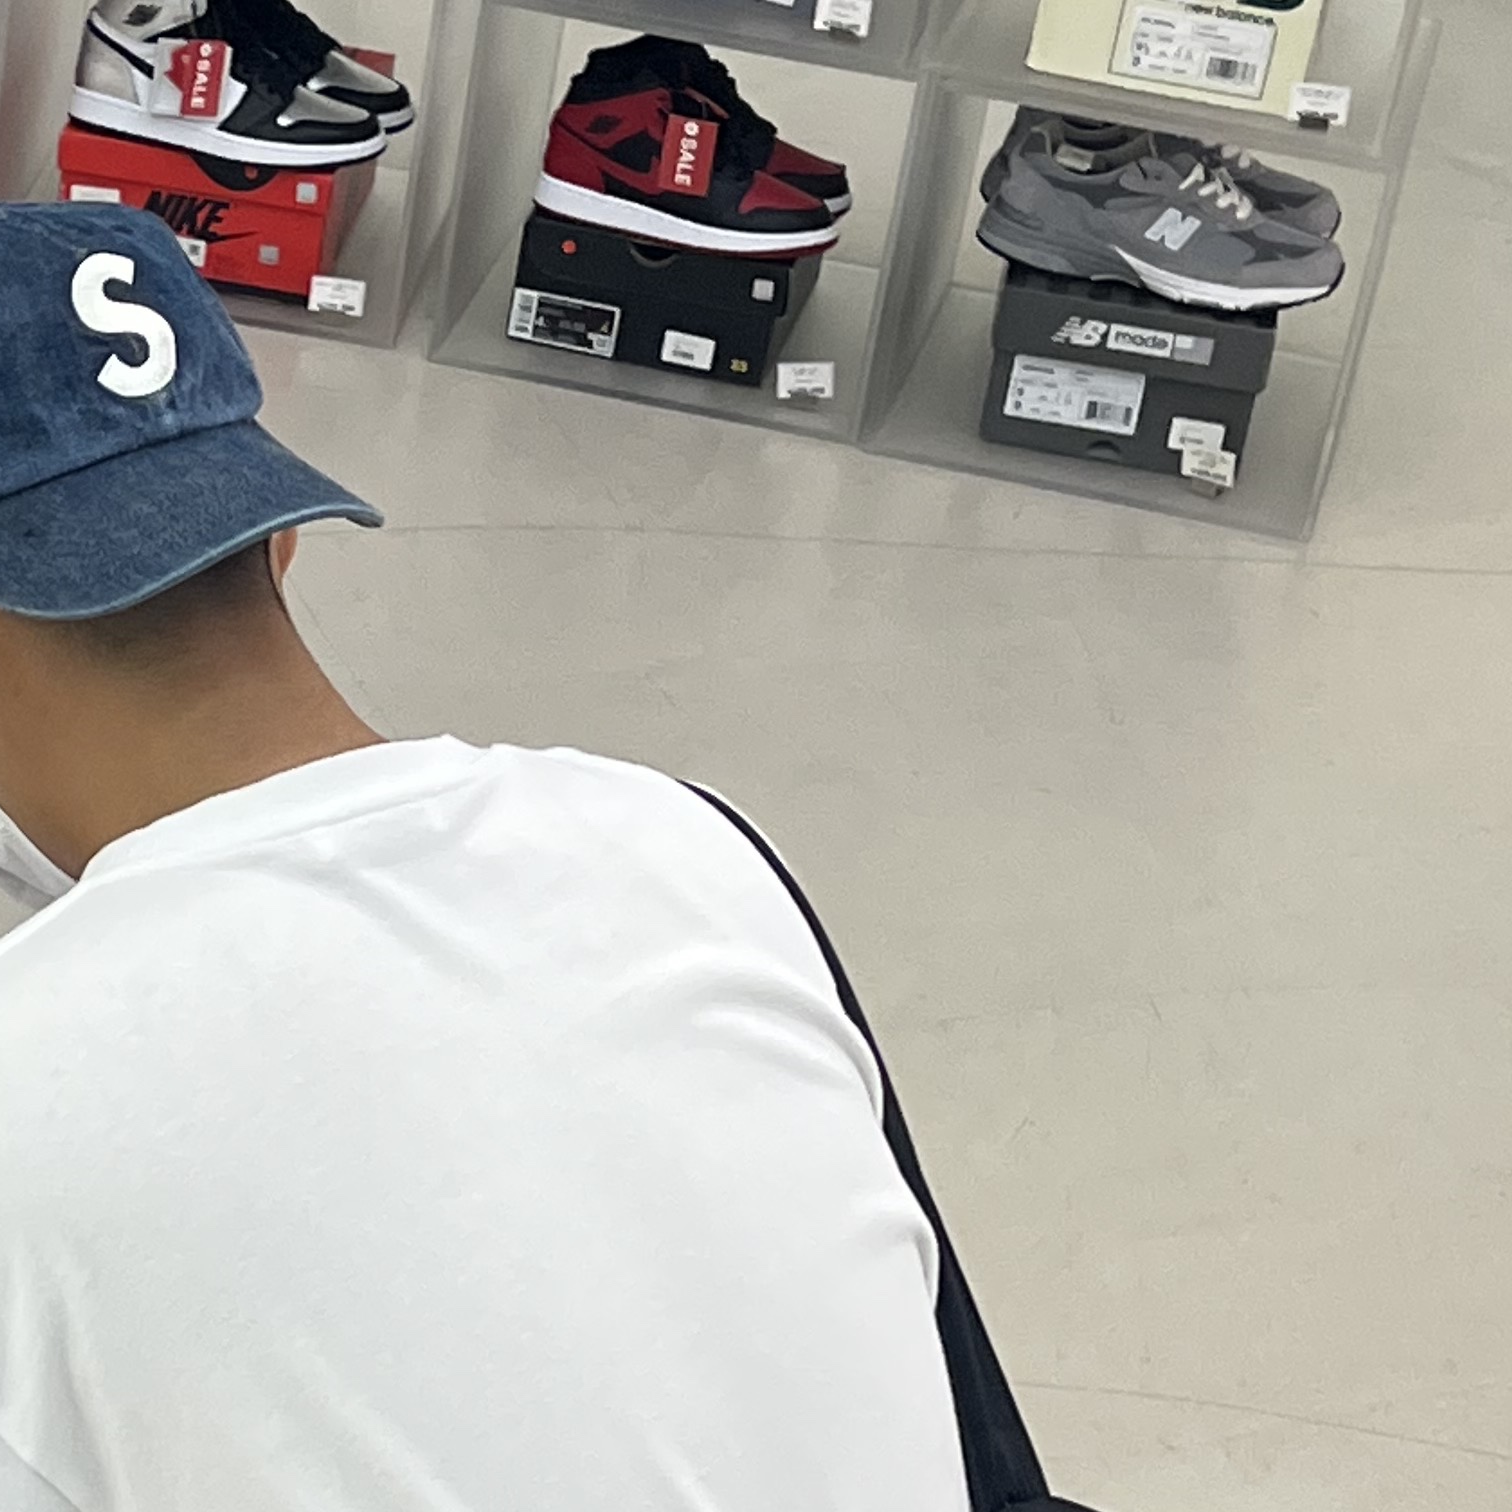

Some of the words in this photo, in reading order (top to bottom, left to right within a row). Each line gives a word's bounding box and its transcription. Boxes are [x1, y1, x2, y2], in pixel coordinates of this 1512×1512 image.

[191, 59, 211, 109] SALE
[674, 137, 698, 187] SALE
[71, 252, 176, 397] S
[1114, 329, 1169, 350] made
